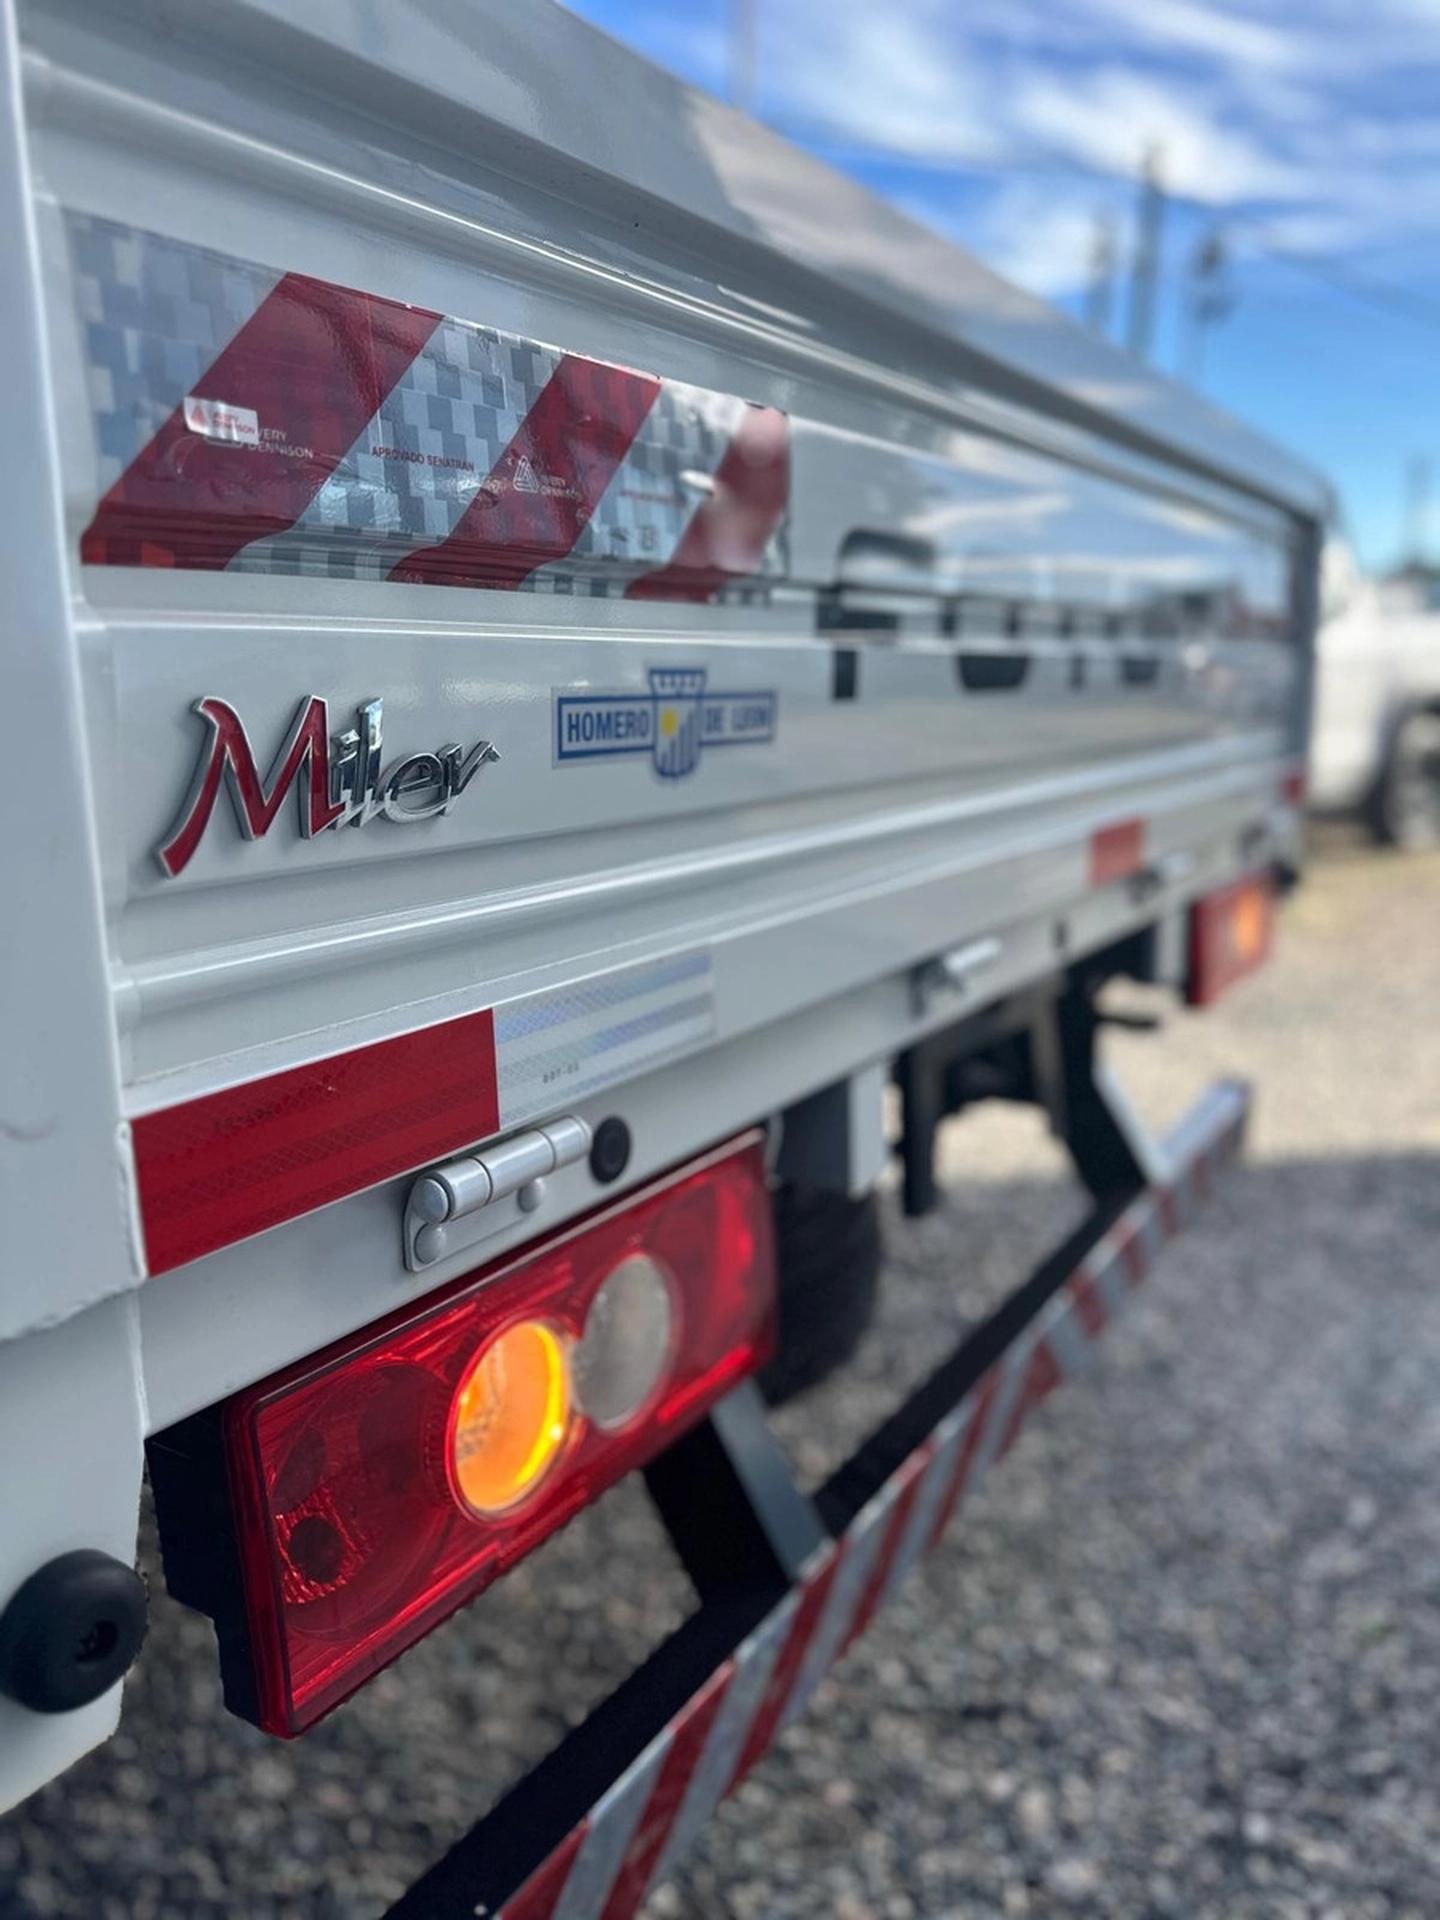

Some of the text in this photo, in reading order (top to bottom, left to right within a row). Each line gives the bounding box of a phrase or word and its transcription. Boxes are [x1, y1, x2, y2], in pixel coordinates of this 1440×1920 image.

[371, 446, 475, 472] APROVADO SENATRAN
[567, 709, 650, 744] HOMERO
[156, 694, 501, 879] Miler
